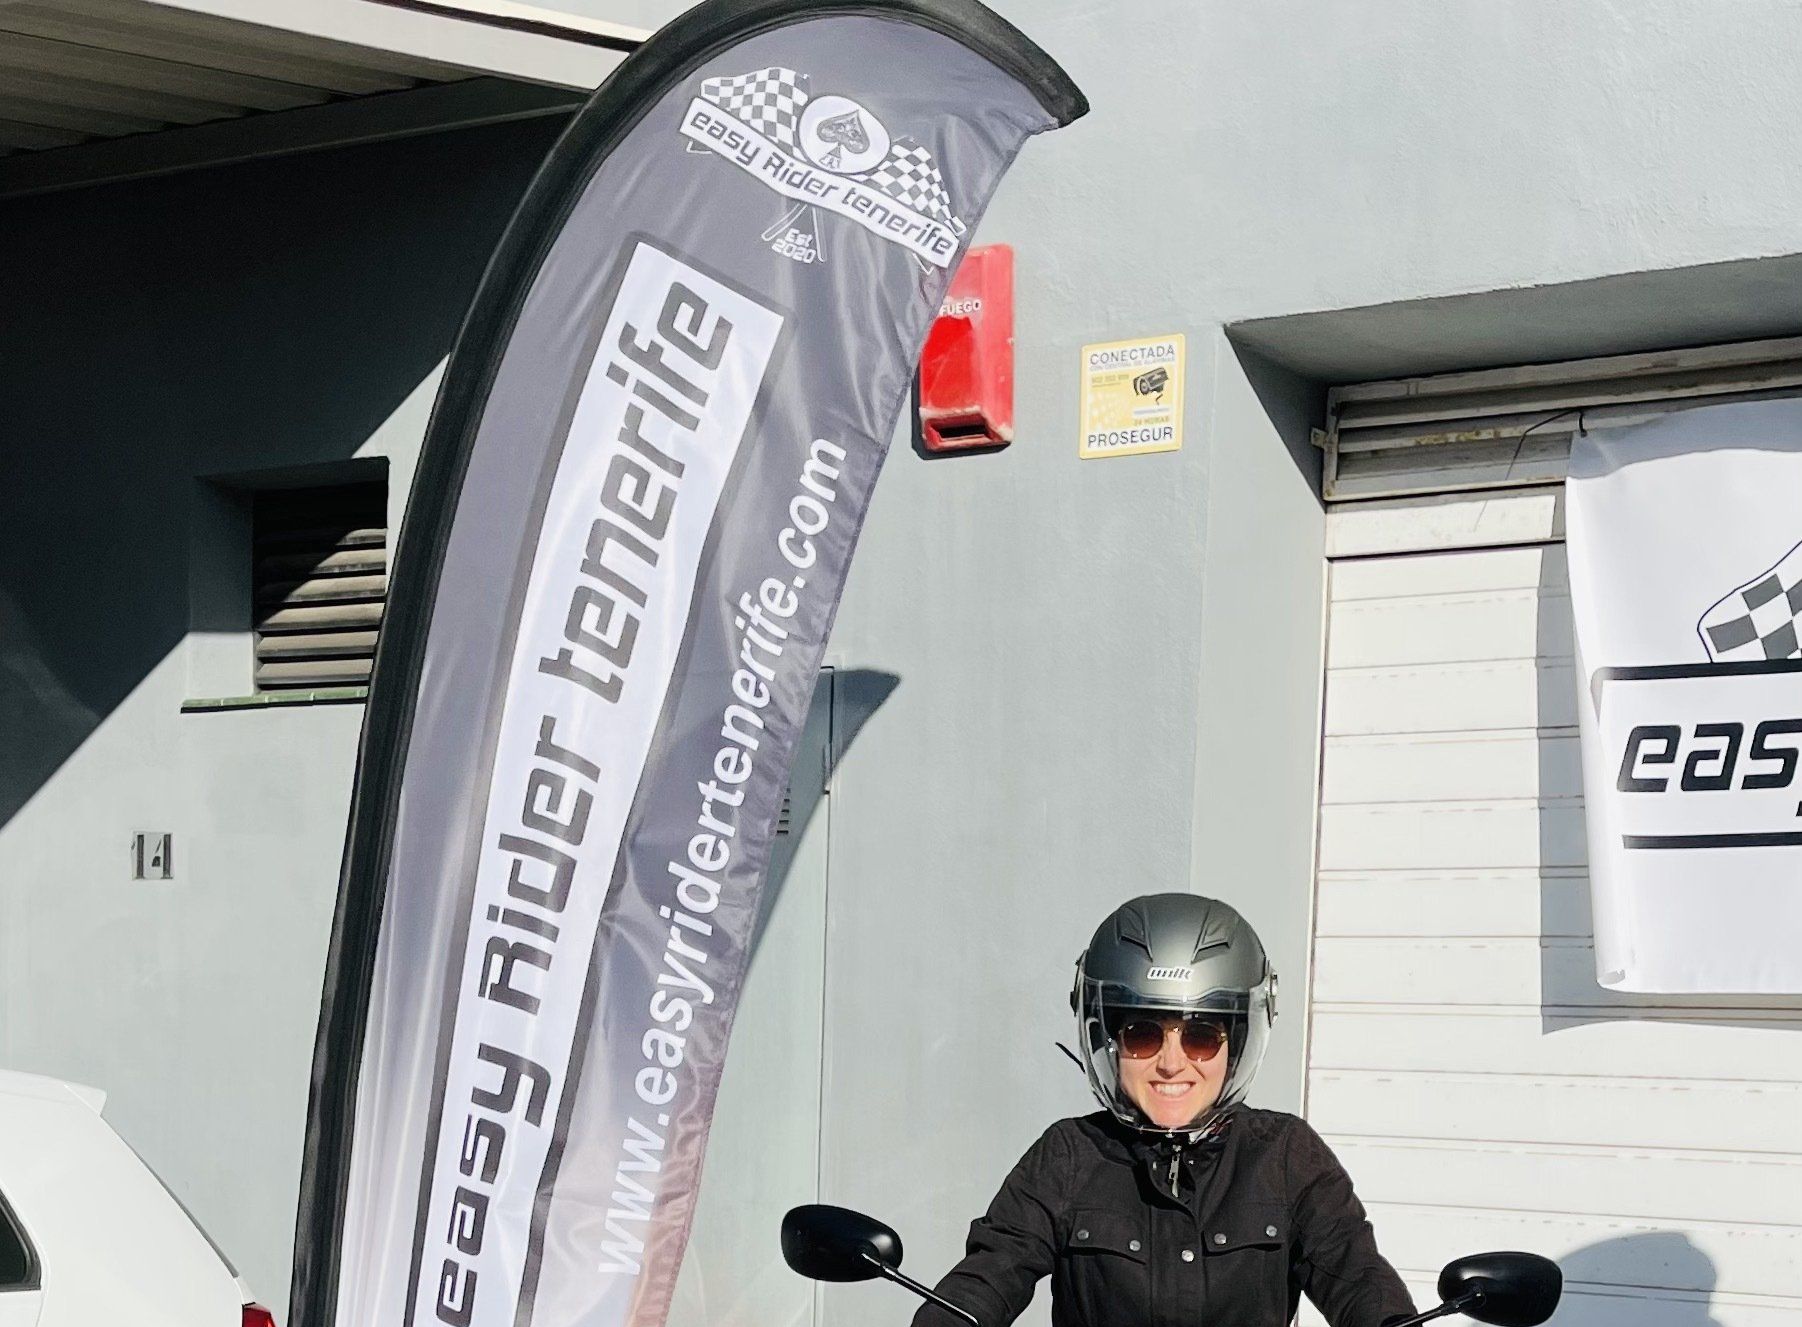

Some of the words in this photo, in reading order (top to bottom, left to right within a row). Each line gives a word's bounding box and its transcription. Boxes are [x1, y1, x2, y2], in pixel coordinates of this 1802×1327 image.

[690, 111, 760, 165] easy
[763, 152, 839, 198] Rider
[842, 187, 951, 255] tenerife
[771, 238, 817, 264] 2020
[1090, 344, 1175, 365] CONECTADA
[1088, 426, 1173, 448] PROSEGUR
[538, 281, 733, 704] tenerife
[1616, 718, 1802, 816] eas
[131, 834, 173, 879] 14
[478, 715, 601, 1017] Rider
[598, 438, 847, 1278] www.easyridertenerife.com
